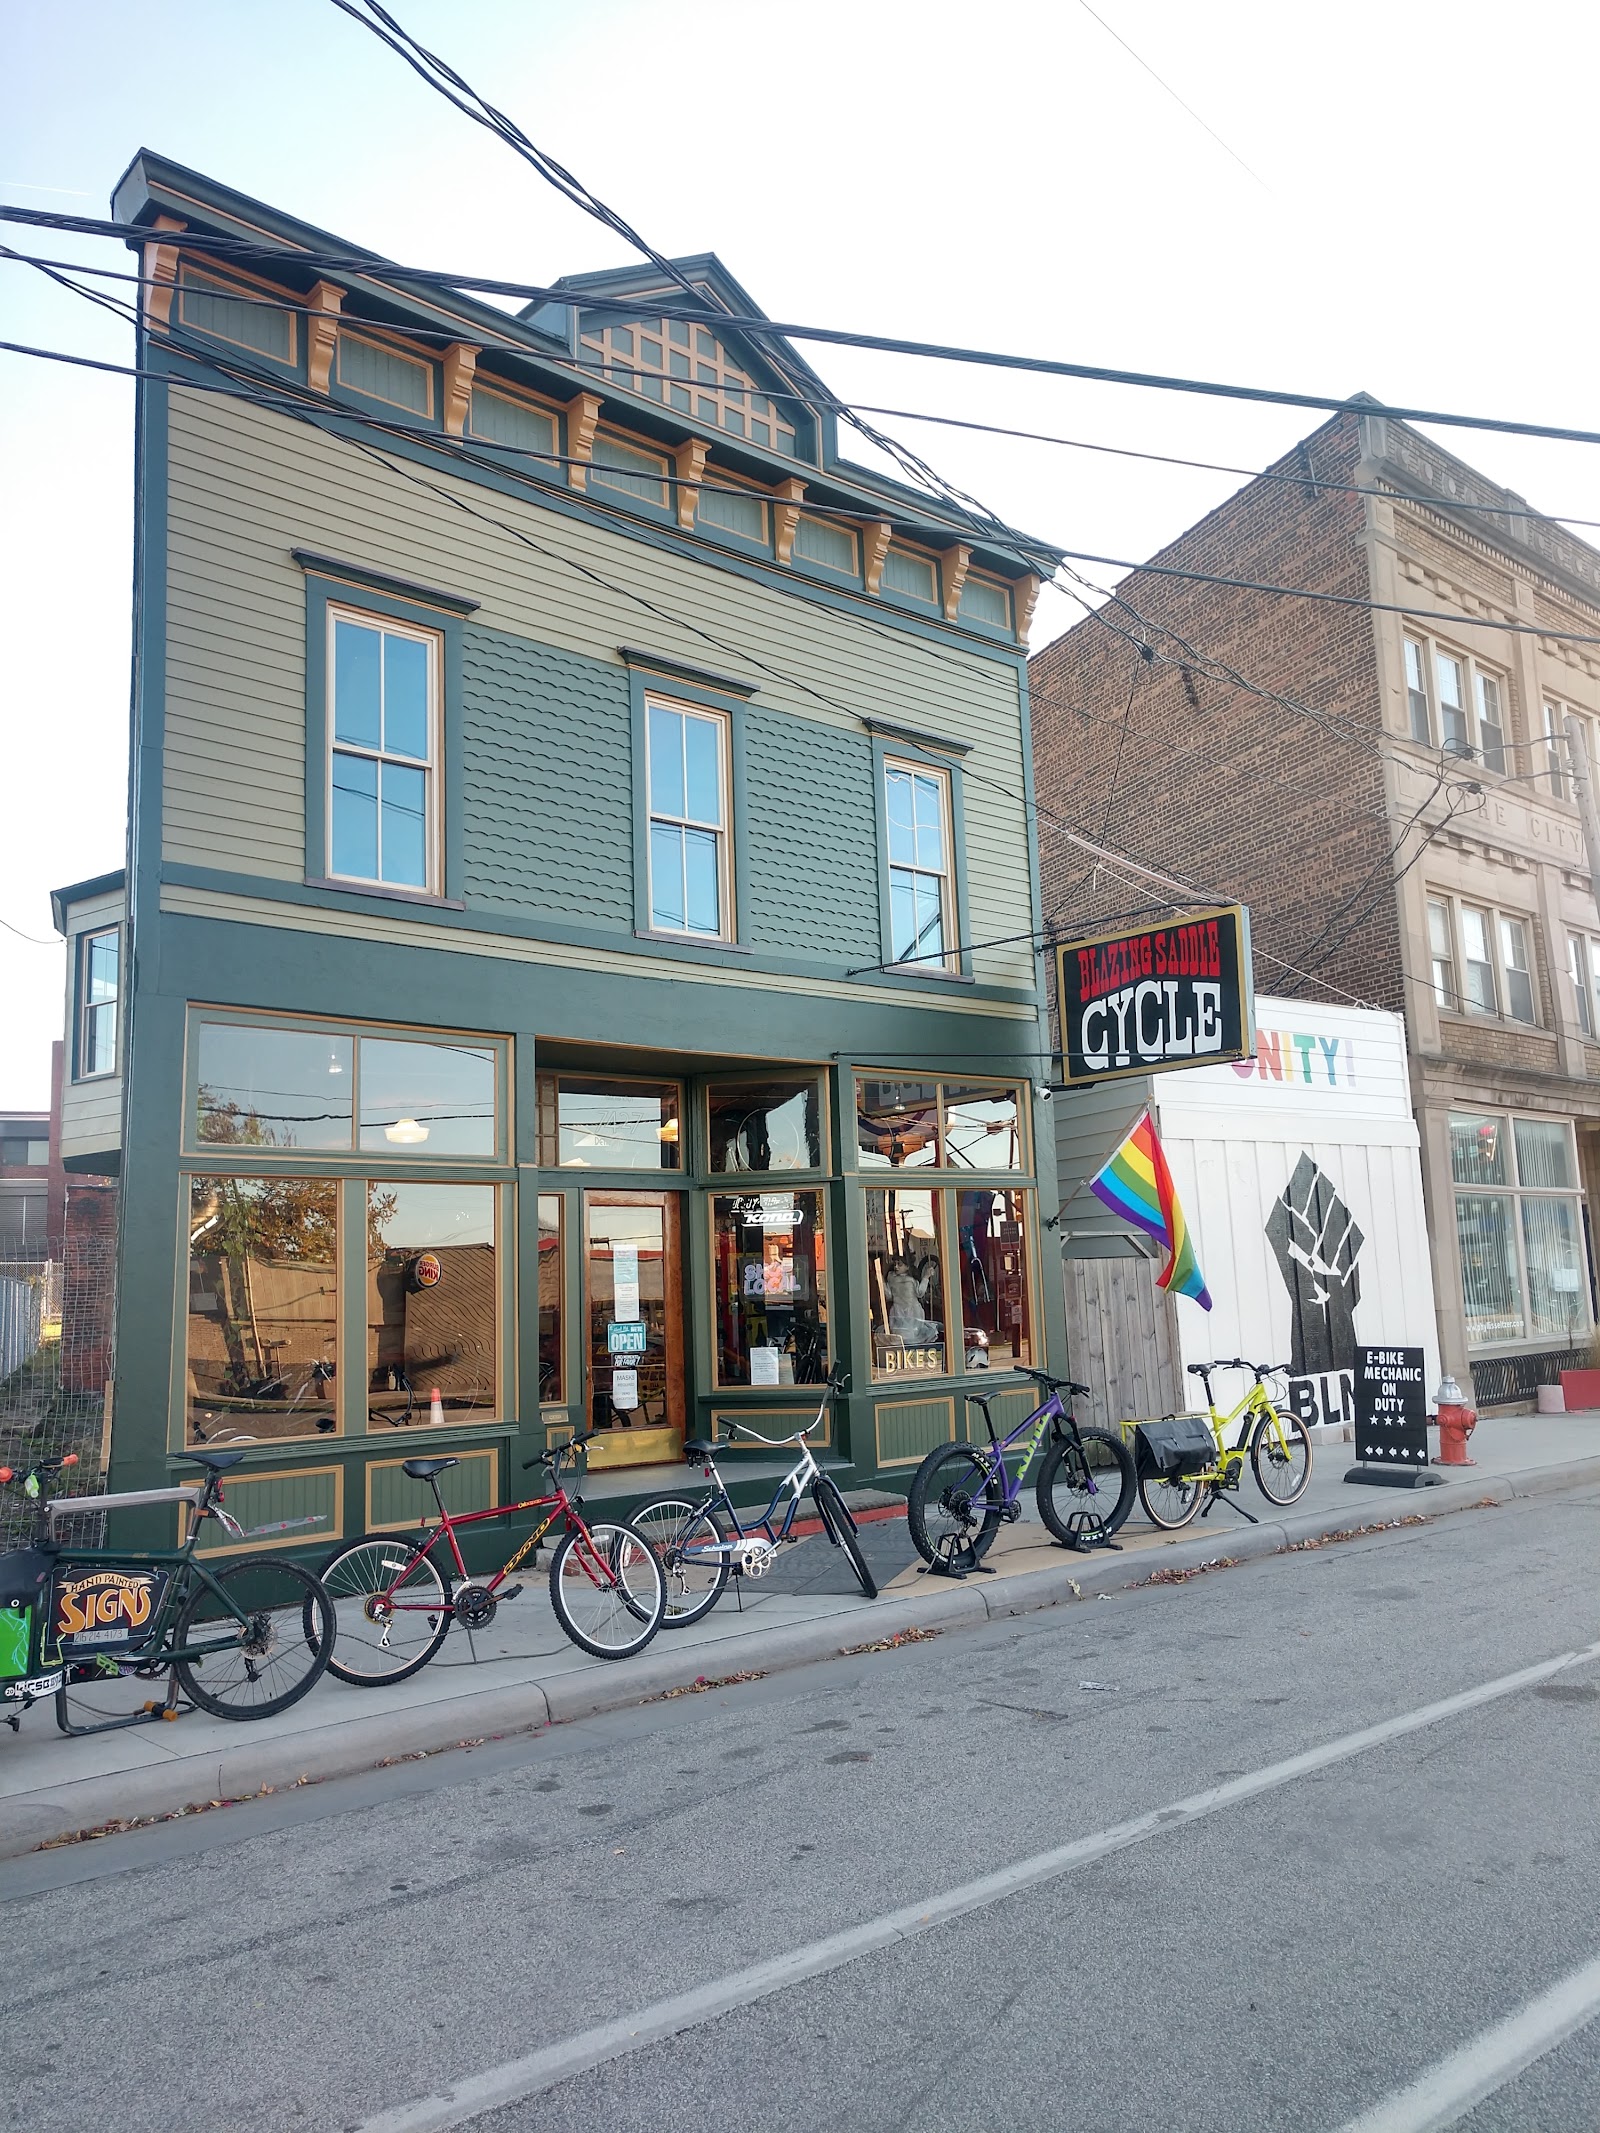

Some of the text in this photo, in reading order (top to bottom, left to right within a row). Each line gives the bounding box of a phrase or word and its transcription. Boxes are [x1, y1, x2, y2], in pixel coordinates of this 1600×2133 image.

[1530, 816, 1582, 855] CITY
[1077, 921, 1222, 1003] BLAZING SADDLE
[1081, 980, 1223, 1070] CYCLE
[595, 1111, 645, 1134] 7427
[743, 1273, 801, 1296] LOCAL
[611, 1332, 643, 1351] OPEN
[885, 1347, 938, 1375] BIKES
[1366, 1351, 1405, 1365] E-BIKE
[1364, 1366, 1422, 1382] MECHANIC
[1381, 1382, 1397, 1396] ON
[1374, 1397, 1405, 1413] DUTY
[503, 1517, 550, 1575] DYNO
[70, 1573, 140, 1594] HAND PAINTED
[57, 1585, 152, 1634] SIGNS
[74, 1629, 123, 1643] 216 214 4173
